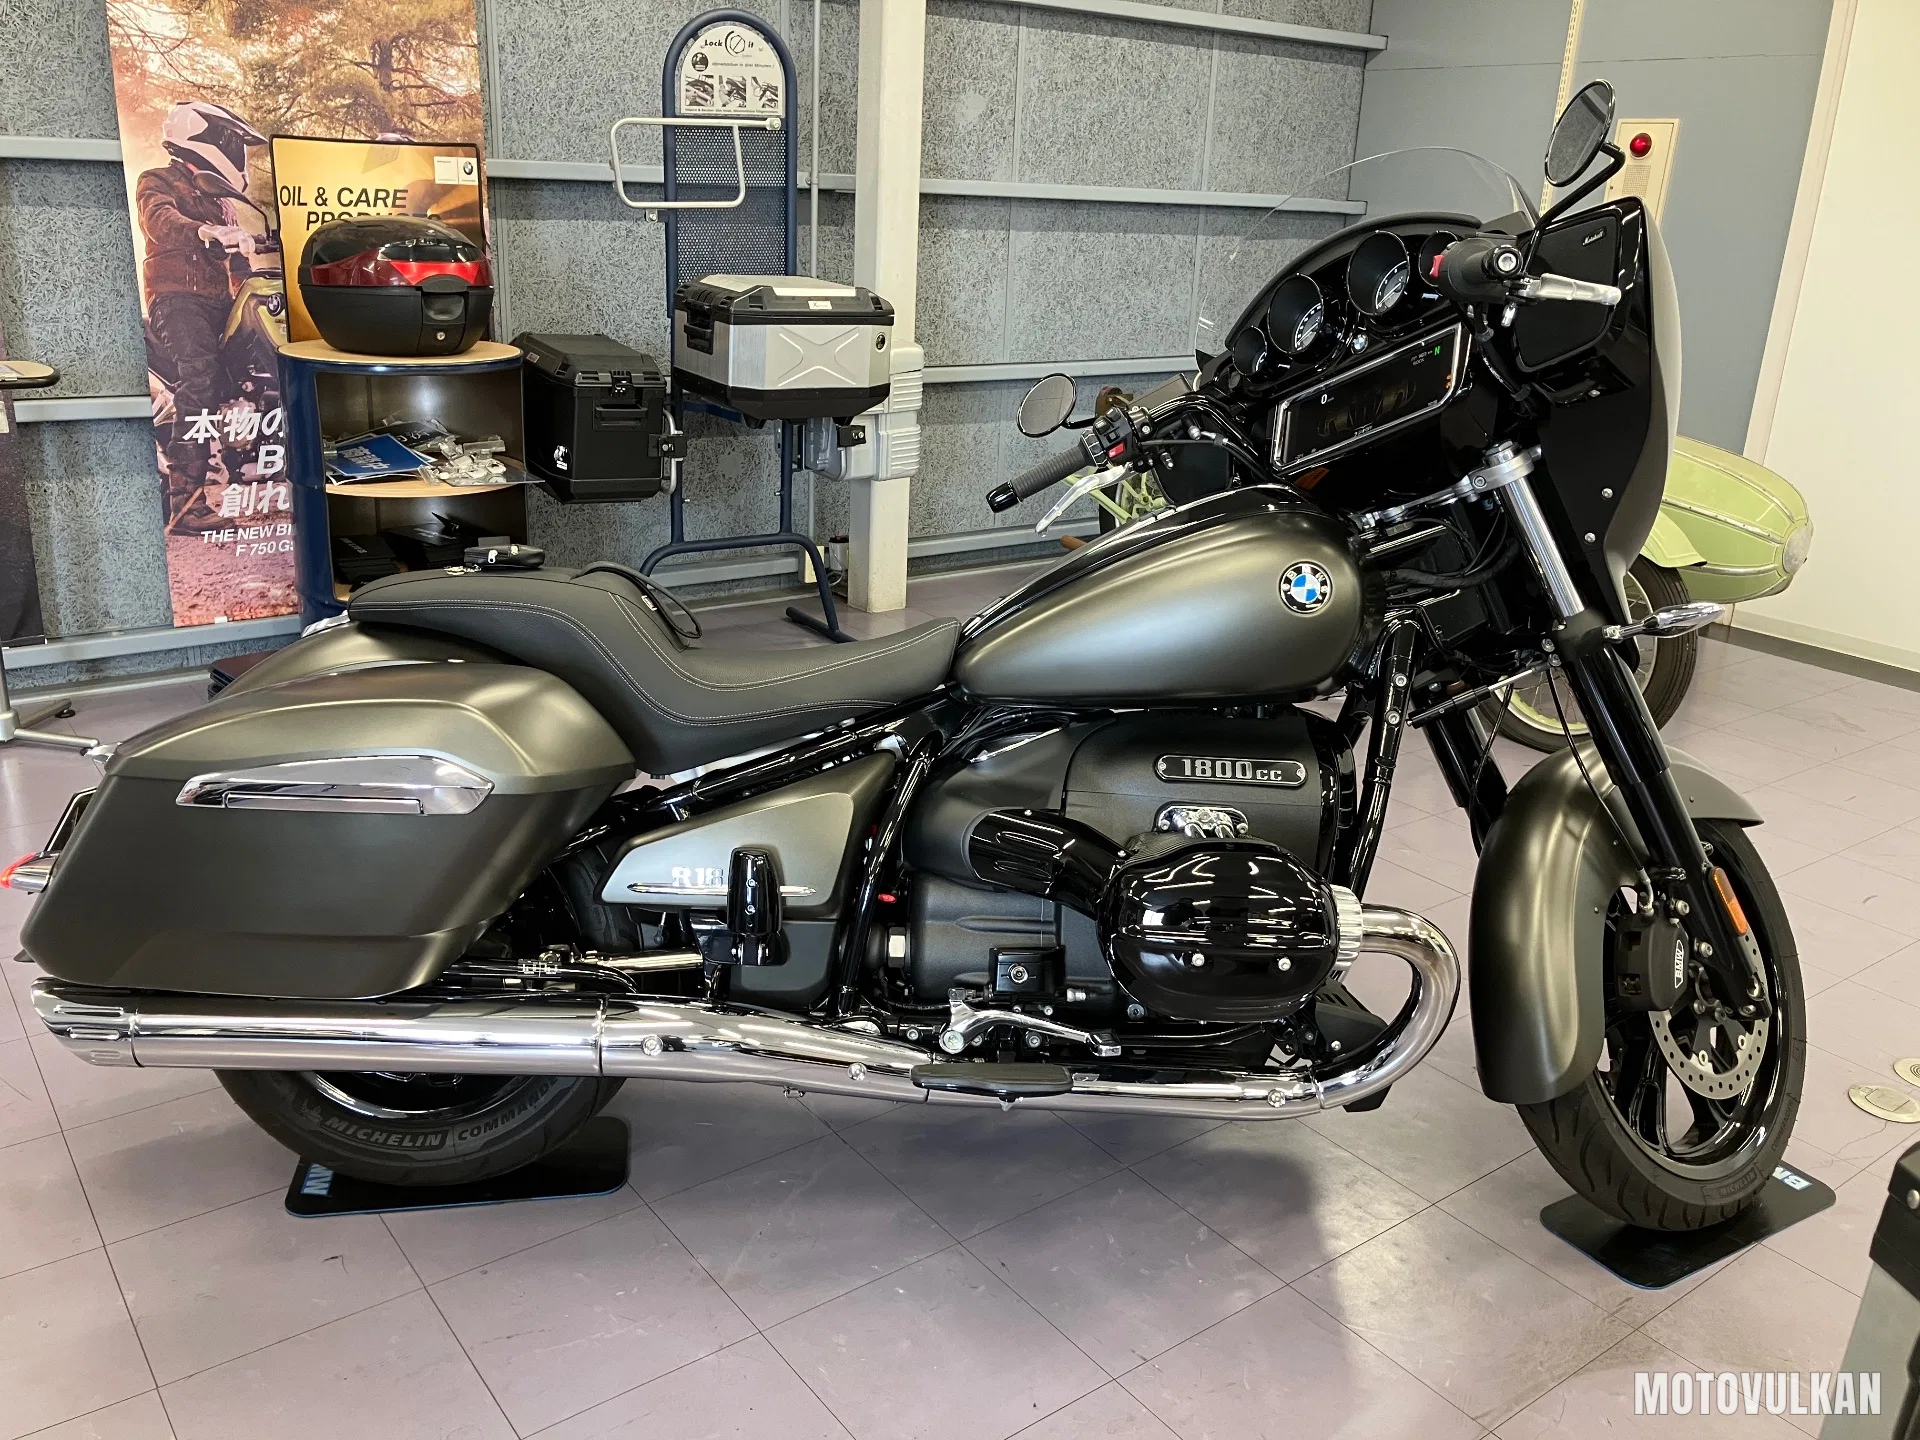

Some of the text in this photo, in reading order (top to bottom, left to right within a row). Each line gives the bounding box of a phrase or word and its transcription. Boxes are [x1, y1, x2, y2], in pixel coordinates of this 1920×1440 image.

[704, 39, 723, 47] Lock
[279, 185, 409, 209] OIL & CARE
[1434, 345, 1441, 355] N
[1320, 393, 1328, 405] 0
[182, 407, 284, 444] 本物の
[218, 480, 290, 518] 創れ
[201, 528, 238, 544] THE
[237, 525, 278, 541] NEW
[236, 544, 248, 557] F
[250, 541, 276, 556] 750
[1675, 949, 1684, 978] BMW
[324, 1116, 443, 1148] MICHELIN
